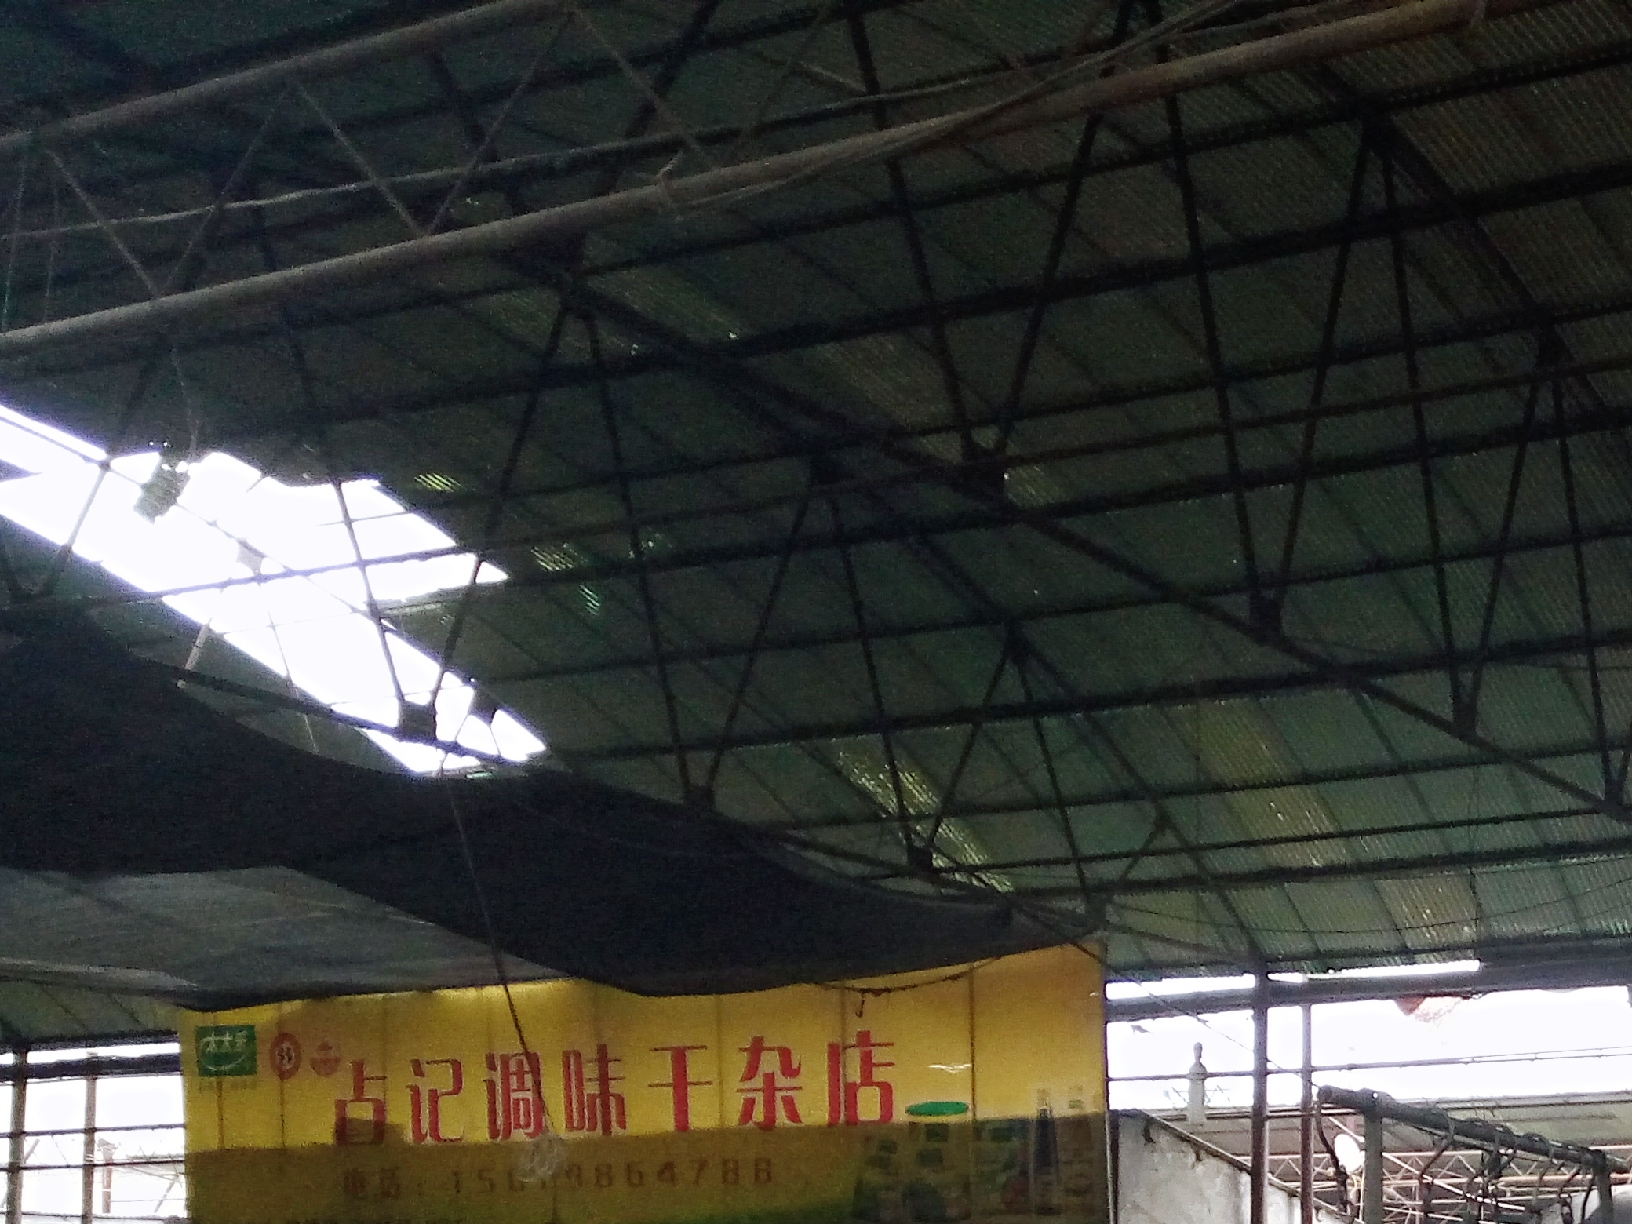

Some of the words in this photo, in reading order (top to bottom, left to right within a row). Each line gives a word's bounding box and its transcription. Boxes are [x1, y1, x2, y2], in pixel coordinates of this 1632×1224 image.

[333, 1029, 895, 1147] 占记调味干杂店
